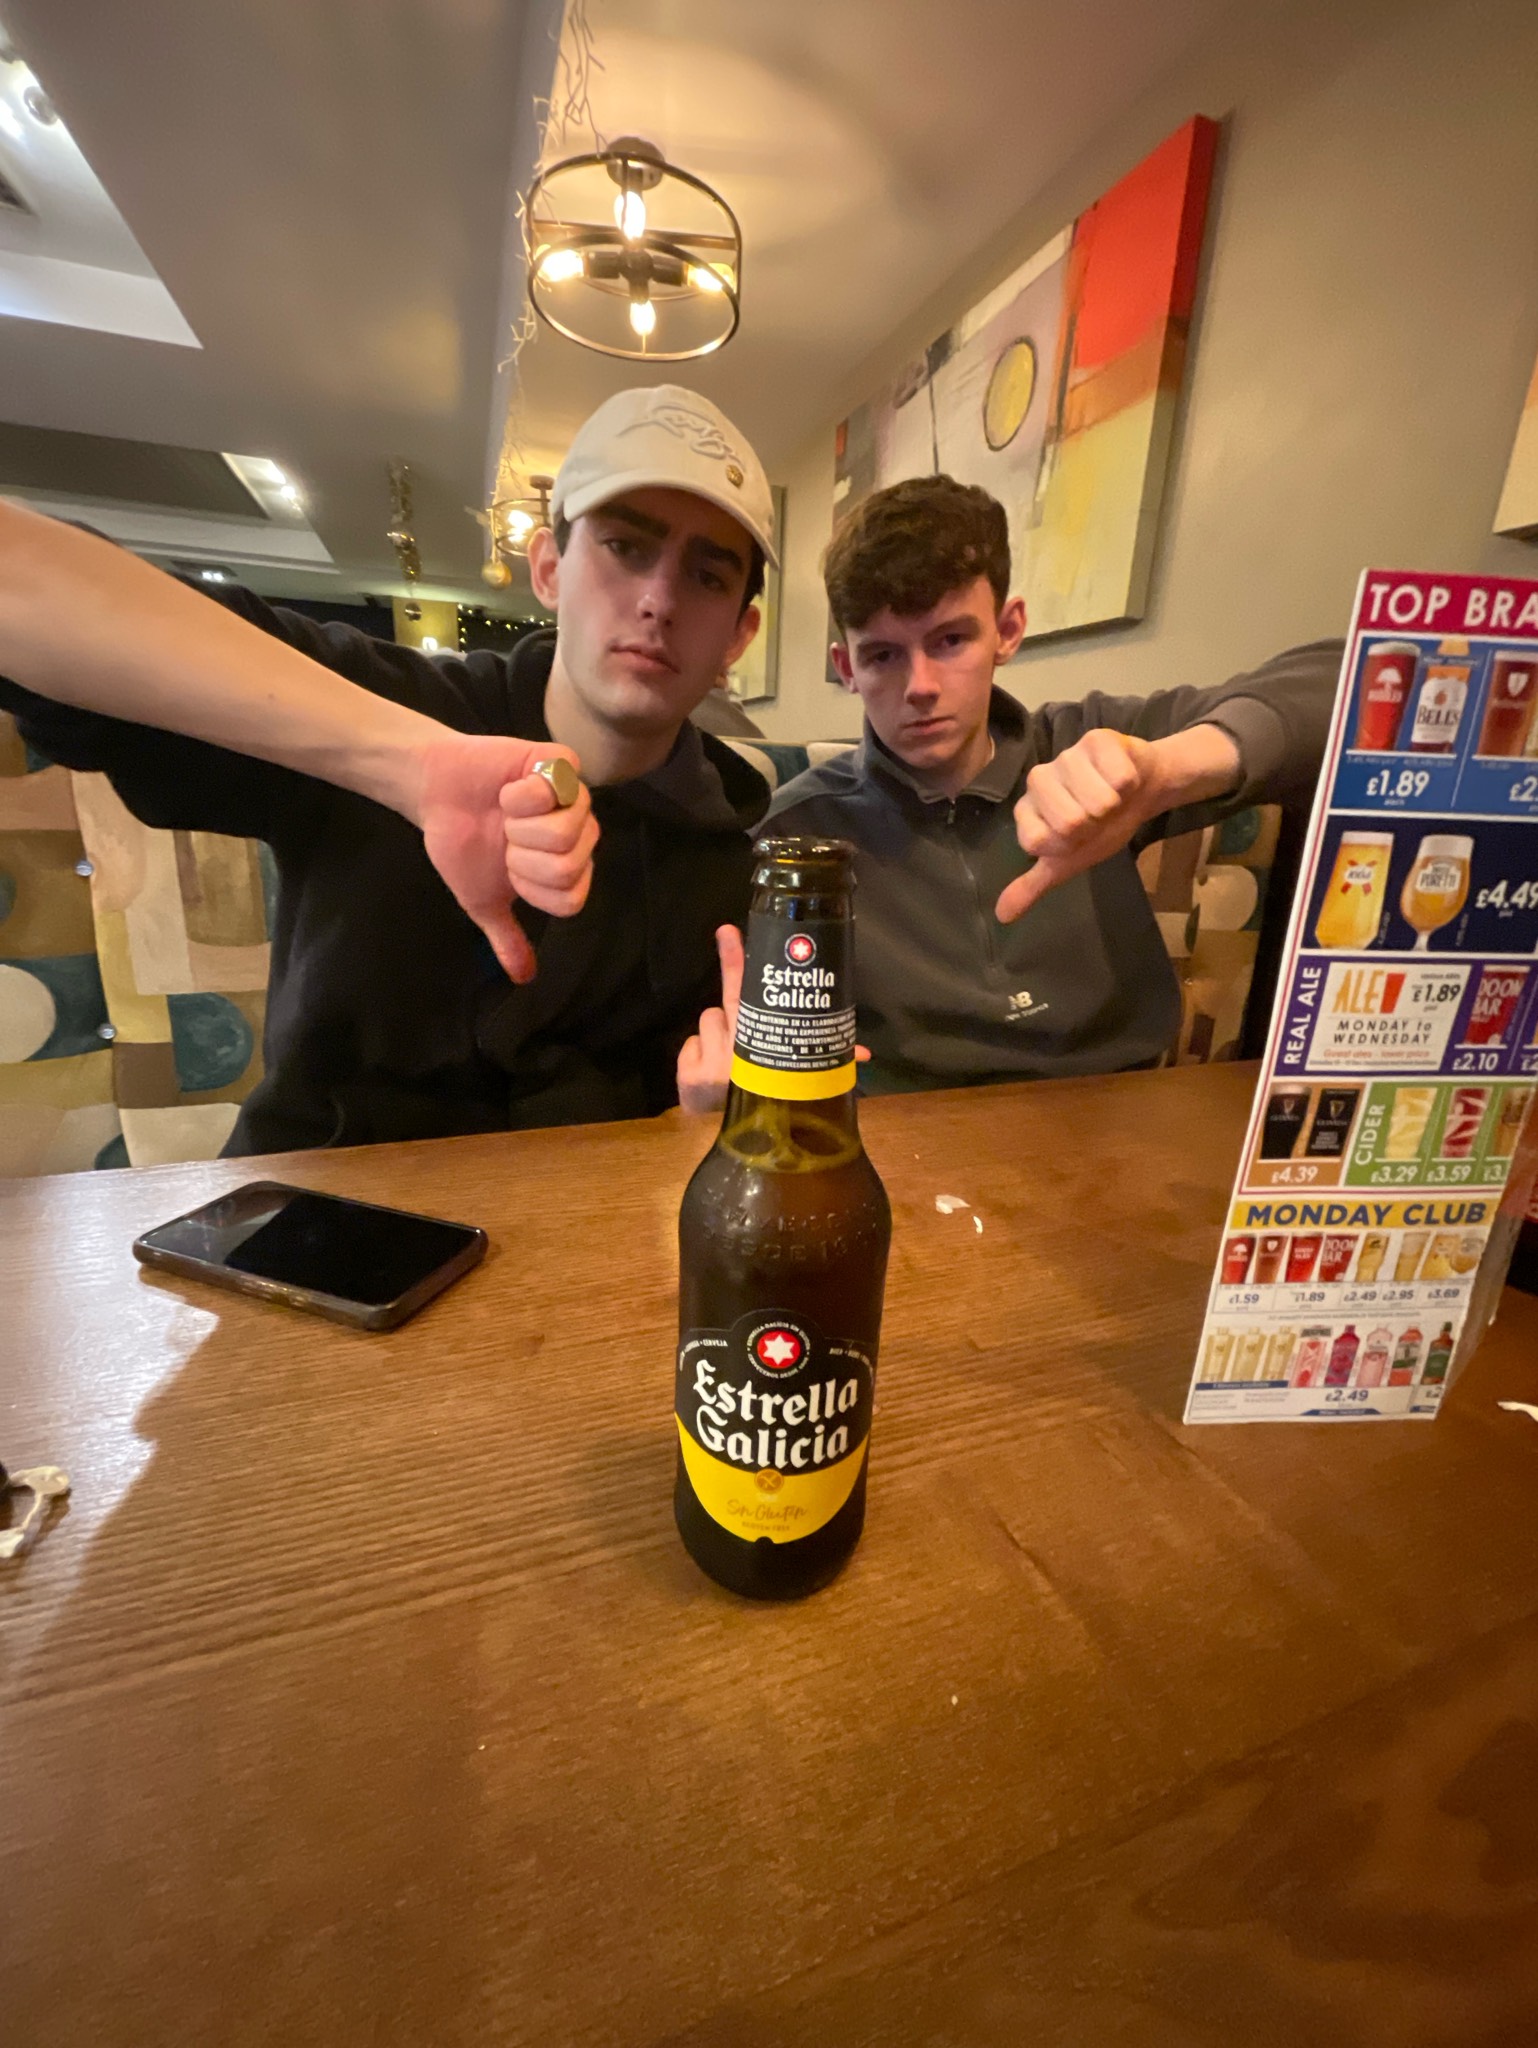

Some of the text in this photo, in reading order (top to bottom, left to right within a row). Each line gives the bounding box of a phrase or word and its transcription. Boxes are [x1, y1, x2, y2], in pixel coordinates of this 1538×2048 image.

[1369, 583, 1538, 630] TOP BRA
[1366, 769, 1430, 797] £1.89
[1475, 880, 1538, 909] £4.49
[761, 963, 835, 988] Estrella
[763, 985, 831, 1009] Galicia
[1412, 984, 1461, 1002] £1.89
[1283, 967, 1322, 1065] REAL ALE
[1336, 1020, 1432, 1032] MONDAY to
[1333, 1033, 1431, 1044] WEDNESDAY
[1452, 1052, 1500, 1071] £2.10
[1355, 1104, 1386, 1165] CIDER
[1271, 1166, 1319, 1183] £4.39
[1370, 1165, 1418, 1183] £3.29
[1426, 1165, 1472, 1183] £3.59
[1246, 1202, 1487, 1226] MONDAY CLUB
[1229, 1293, 1260, 1304] £1.59
[692, 1358, 859, 1426] Estrella
[1325, 1389, 1369, 1402] £2.49
[696, 1405, 850, 1469] Galicia
